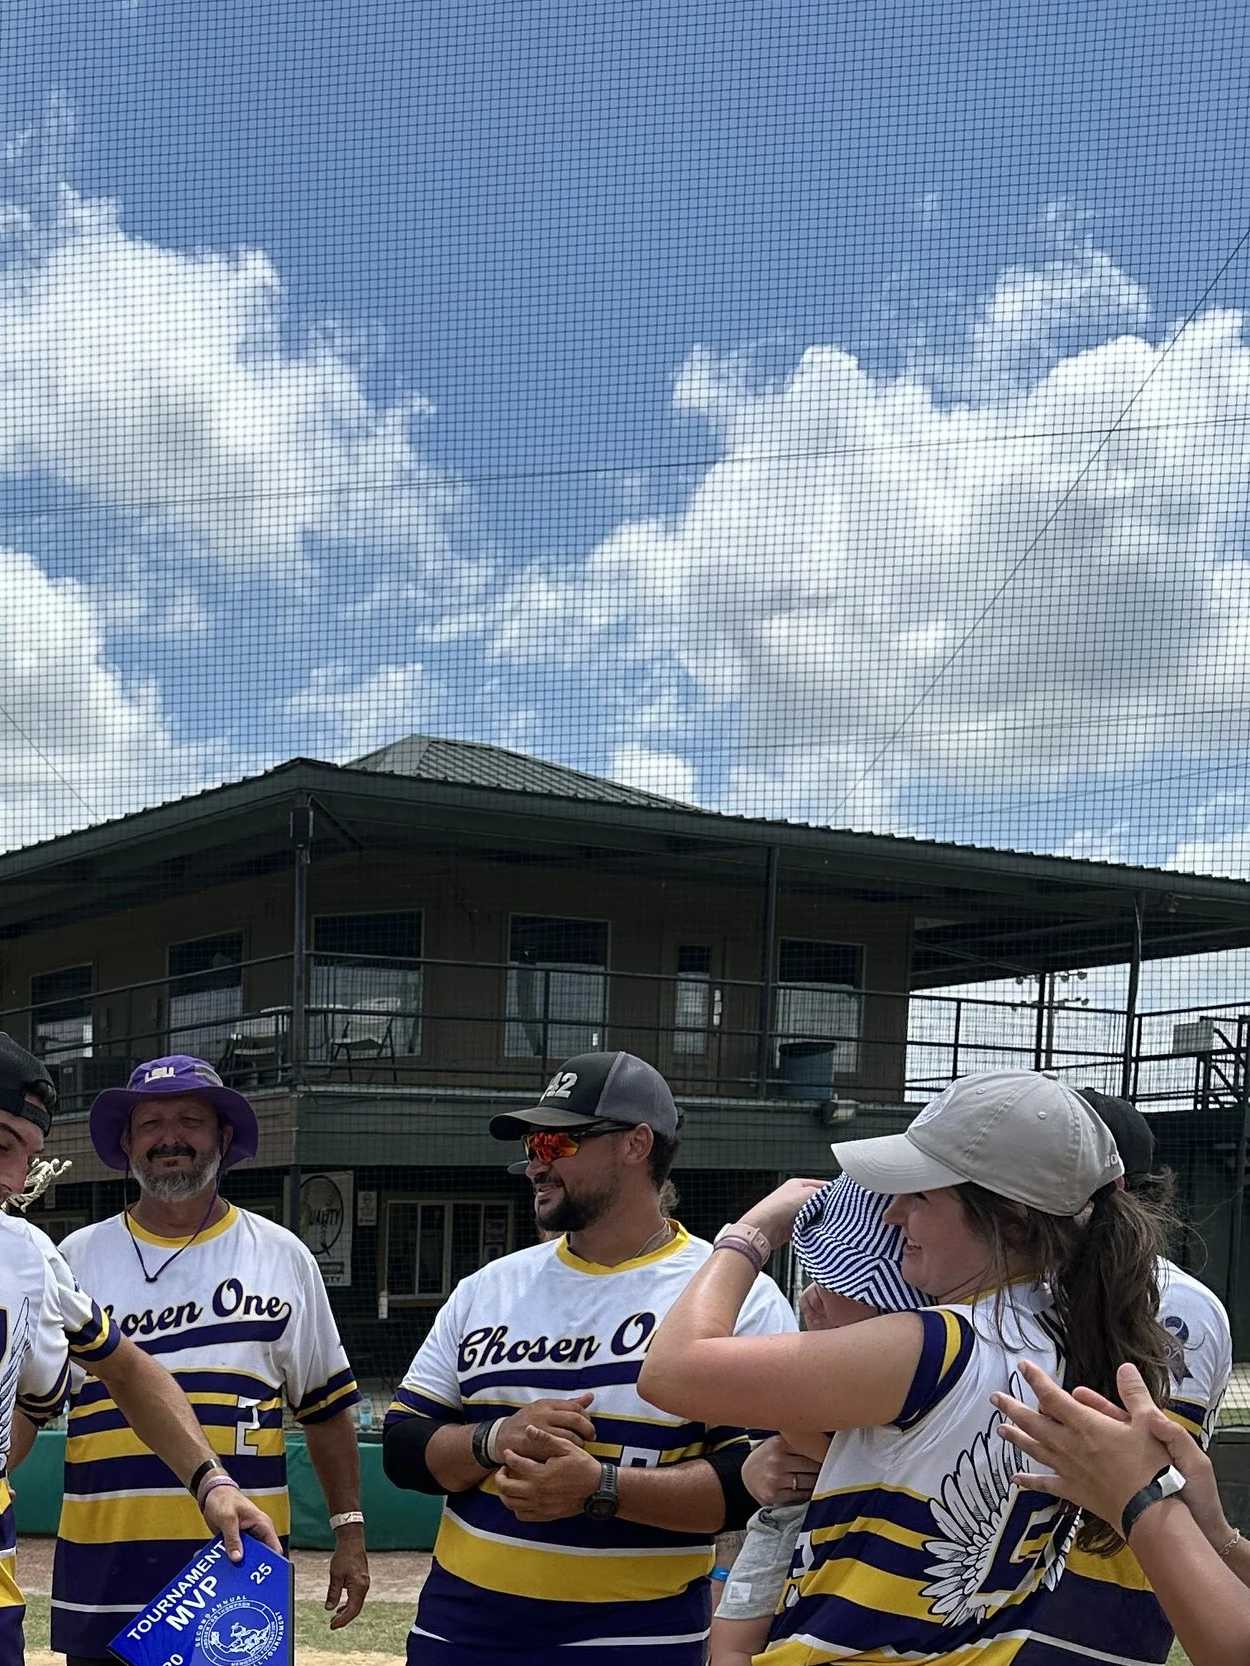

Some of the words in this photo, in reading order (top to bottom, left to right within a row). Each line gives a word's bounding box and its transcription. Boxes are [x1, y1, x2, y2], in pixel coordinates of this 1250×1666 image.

[144, 1066, 174, 1084] LSU
[104, 1301, 204, 1338] osen
[212, 1278, 288, 1318] One
[458, 1325, 601, 1372] Chosen
[236, 1395, 261, 1456] 2
[127, 1540, 226, 1640] TOURNAMENT
[250, 1562, 272, 1585] 25
[165, 1575, 218, 1632] MVP
[195, 1613, 211, 1648] SECOND
[211, 1595, 247, 1613] ANNUAL
[263, 1611, 285, 1661] TOURNAMENT
